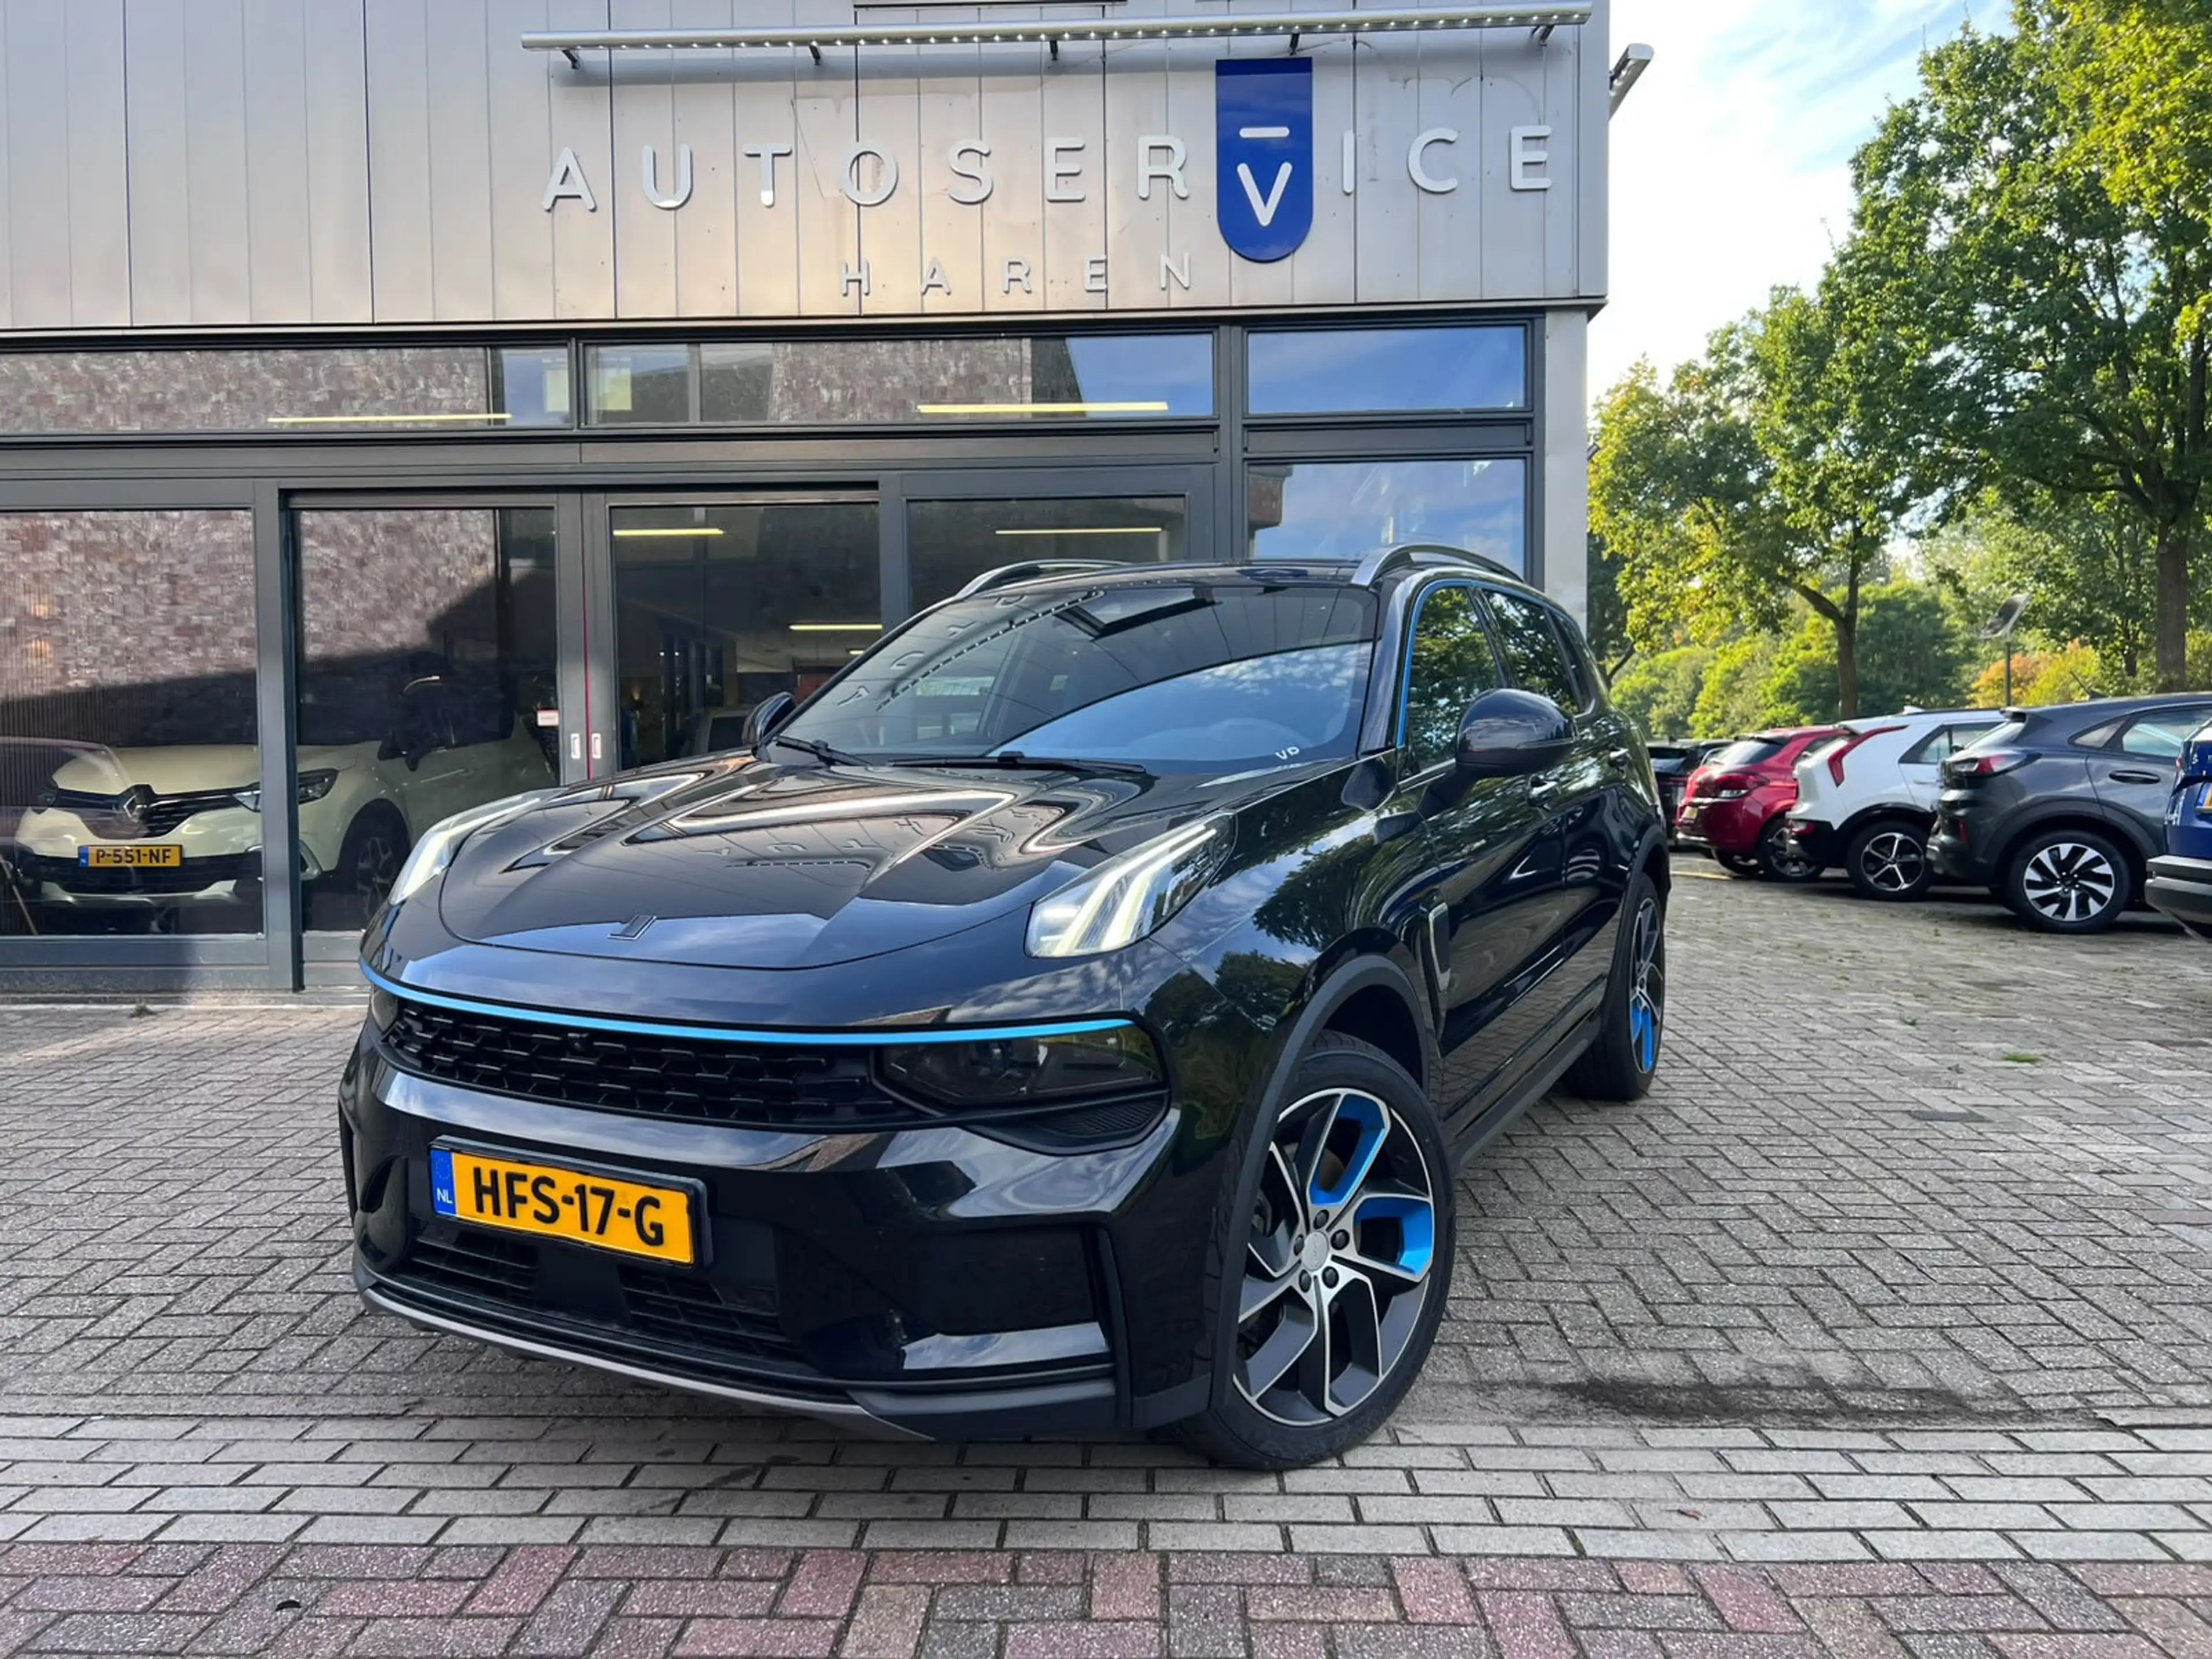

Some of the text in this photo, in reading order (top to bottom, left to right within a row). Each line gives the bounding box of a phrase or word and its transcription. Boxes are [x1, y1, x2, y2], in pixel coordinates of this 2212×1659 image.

[840, 251, 1191, 296] HAREN
[96, 849, 172, 863] P-551-NF
[437, 1166, 664, 1247] NL HFS-17-G
